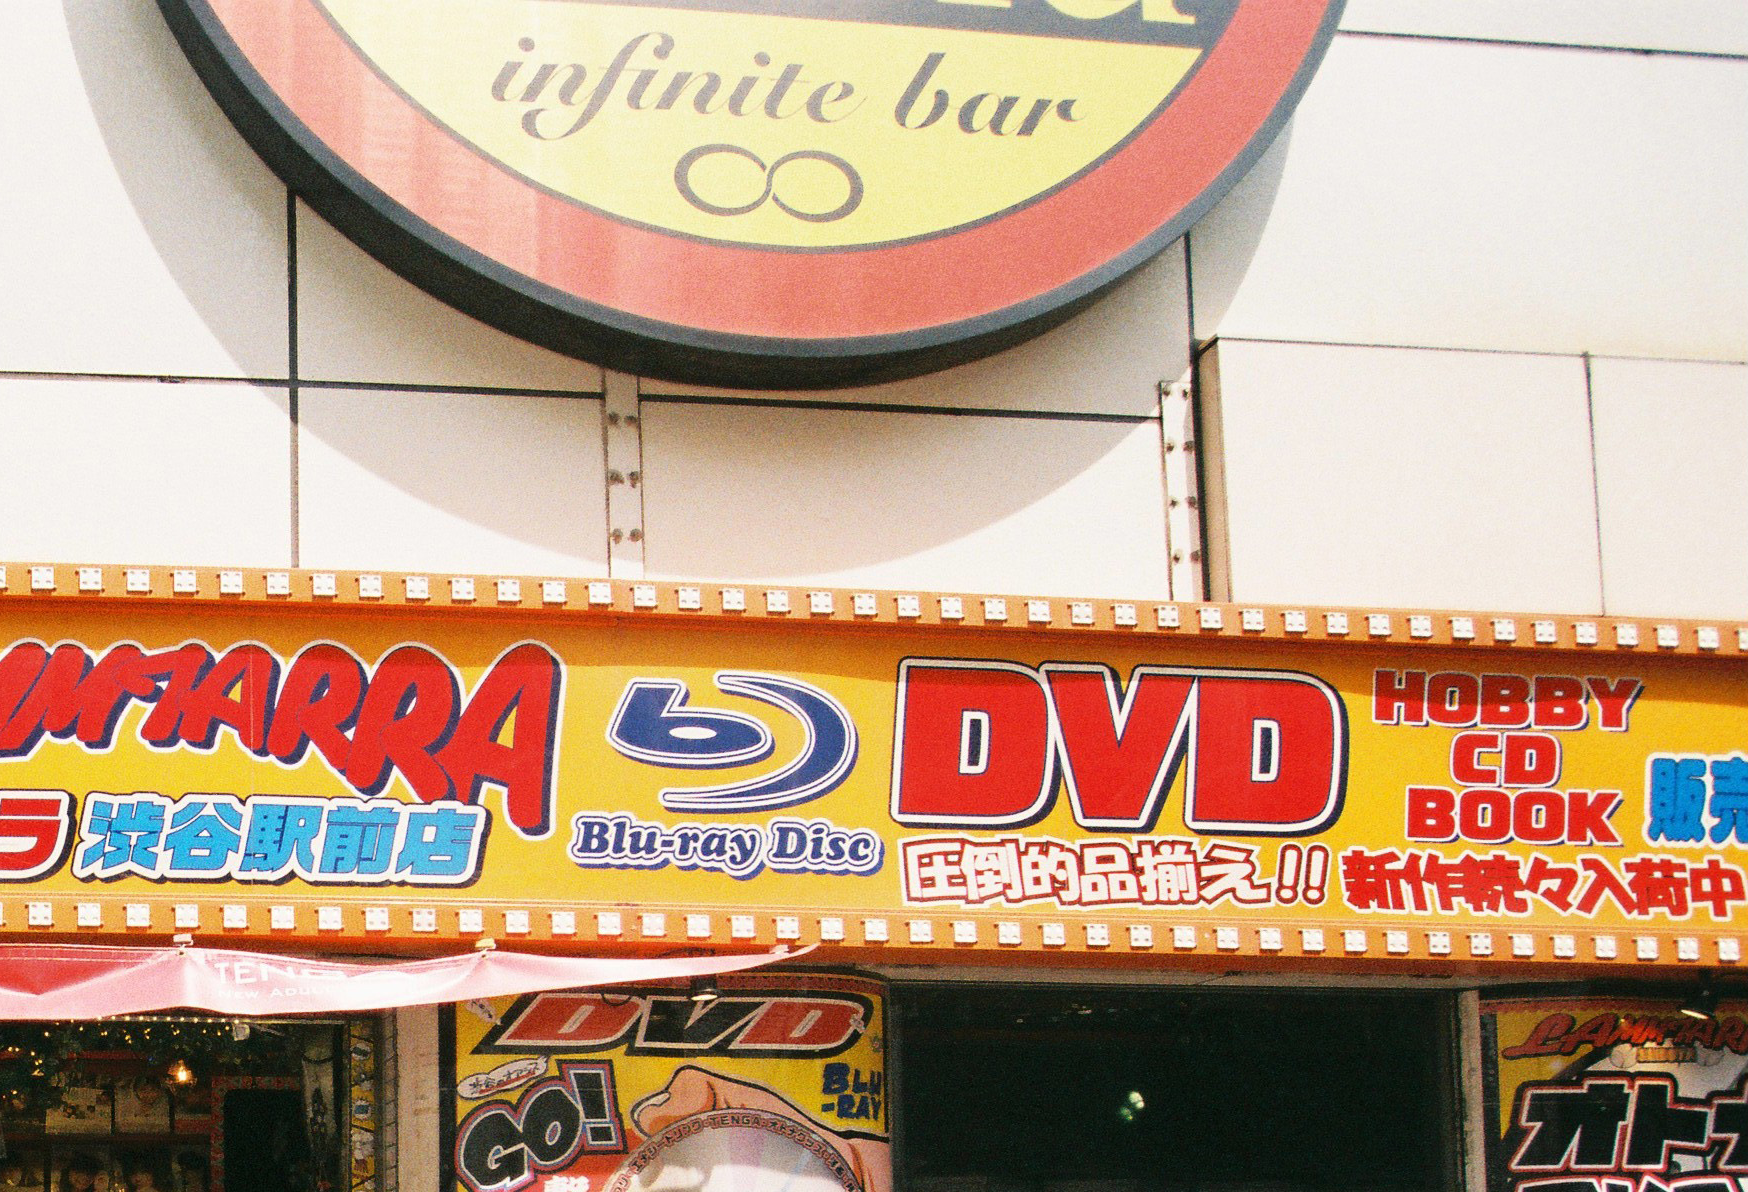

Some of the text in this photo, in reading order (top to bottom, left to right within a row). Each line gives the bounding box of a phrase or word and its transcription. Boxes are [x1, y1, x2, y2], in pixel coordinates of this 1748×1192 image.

[490, 30, 1085, 141] infinite bar
[1374, 670, 1642, 731] HOBBY
[895, 660, 1342, 830] DVD
[1452, 733, 1558, 788] CD
[77, 797, 484, 880] 渋谷駅前店
[1406, 788, 1622, 843] BOOK
[577, 820, 878, 872] Blu-ray Disc
[492, 992, 867, 1051] DVD
[822, 1062, 882, 1095] BLU
[710, 1113, 763, 1127] TENGA
